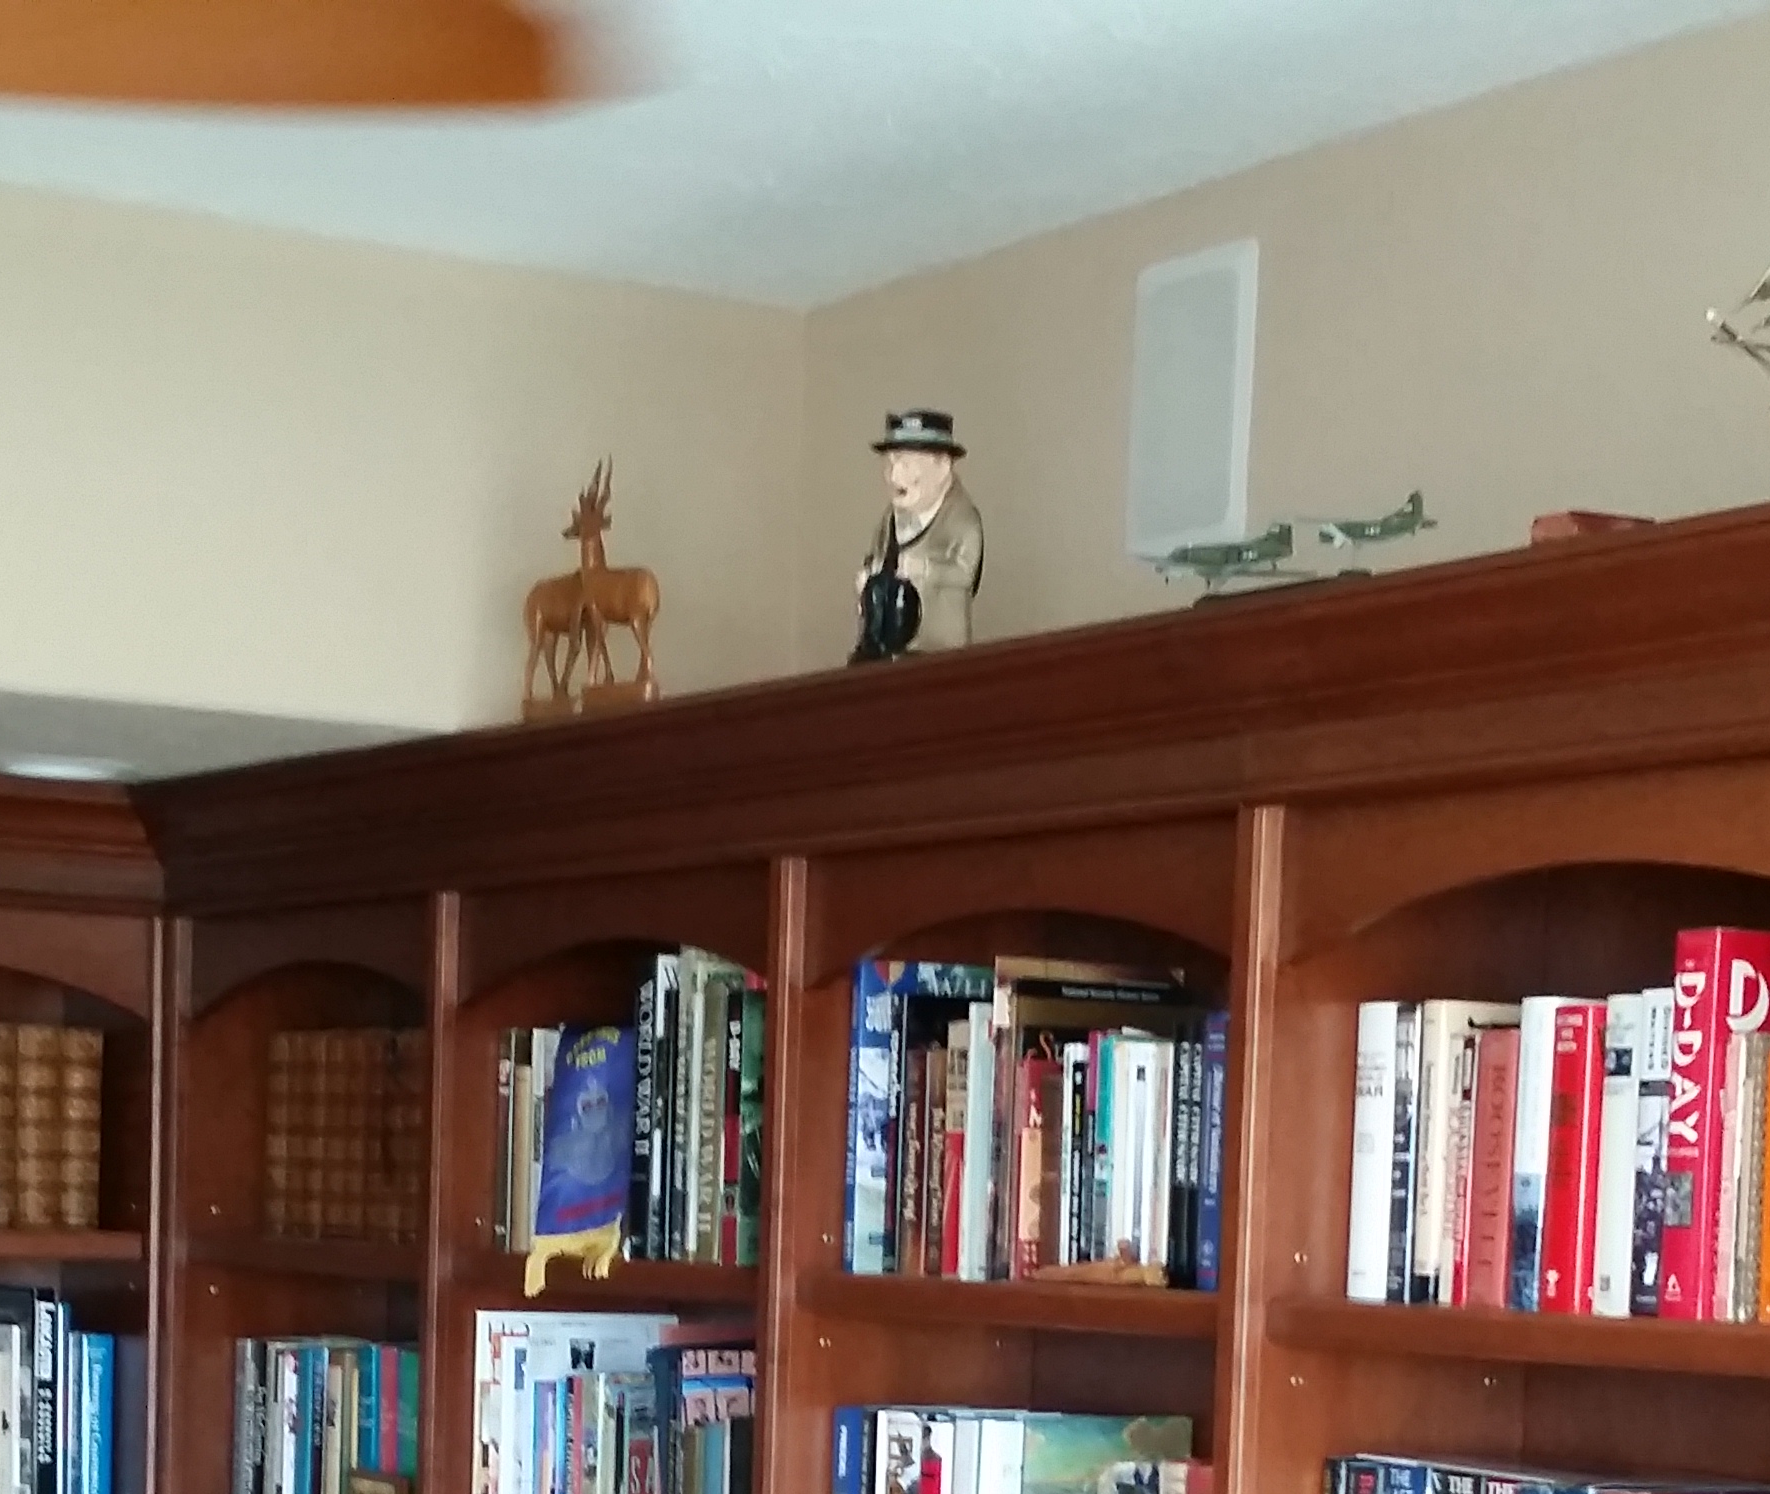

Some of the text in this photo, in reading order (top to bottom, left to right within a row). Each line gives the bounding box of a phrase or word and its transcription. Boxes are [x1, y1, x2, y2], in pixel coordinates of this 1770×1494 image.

[633, 981, 654, 1157] WORLD WAR II
[1667, 972, 1707, 1144] D-DAY
